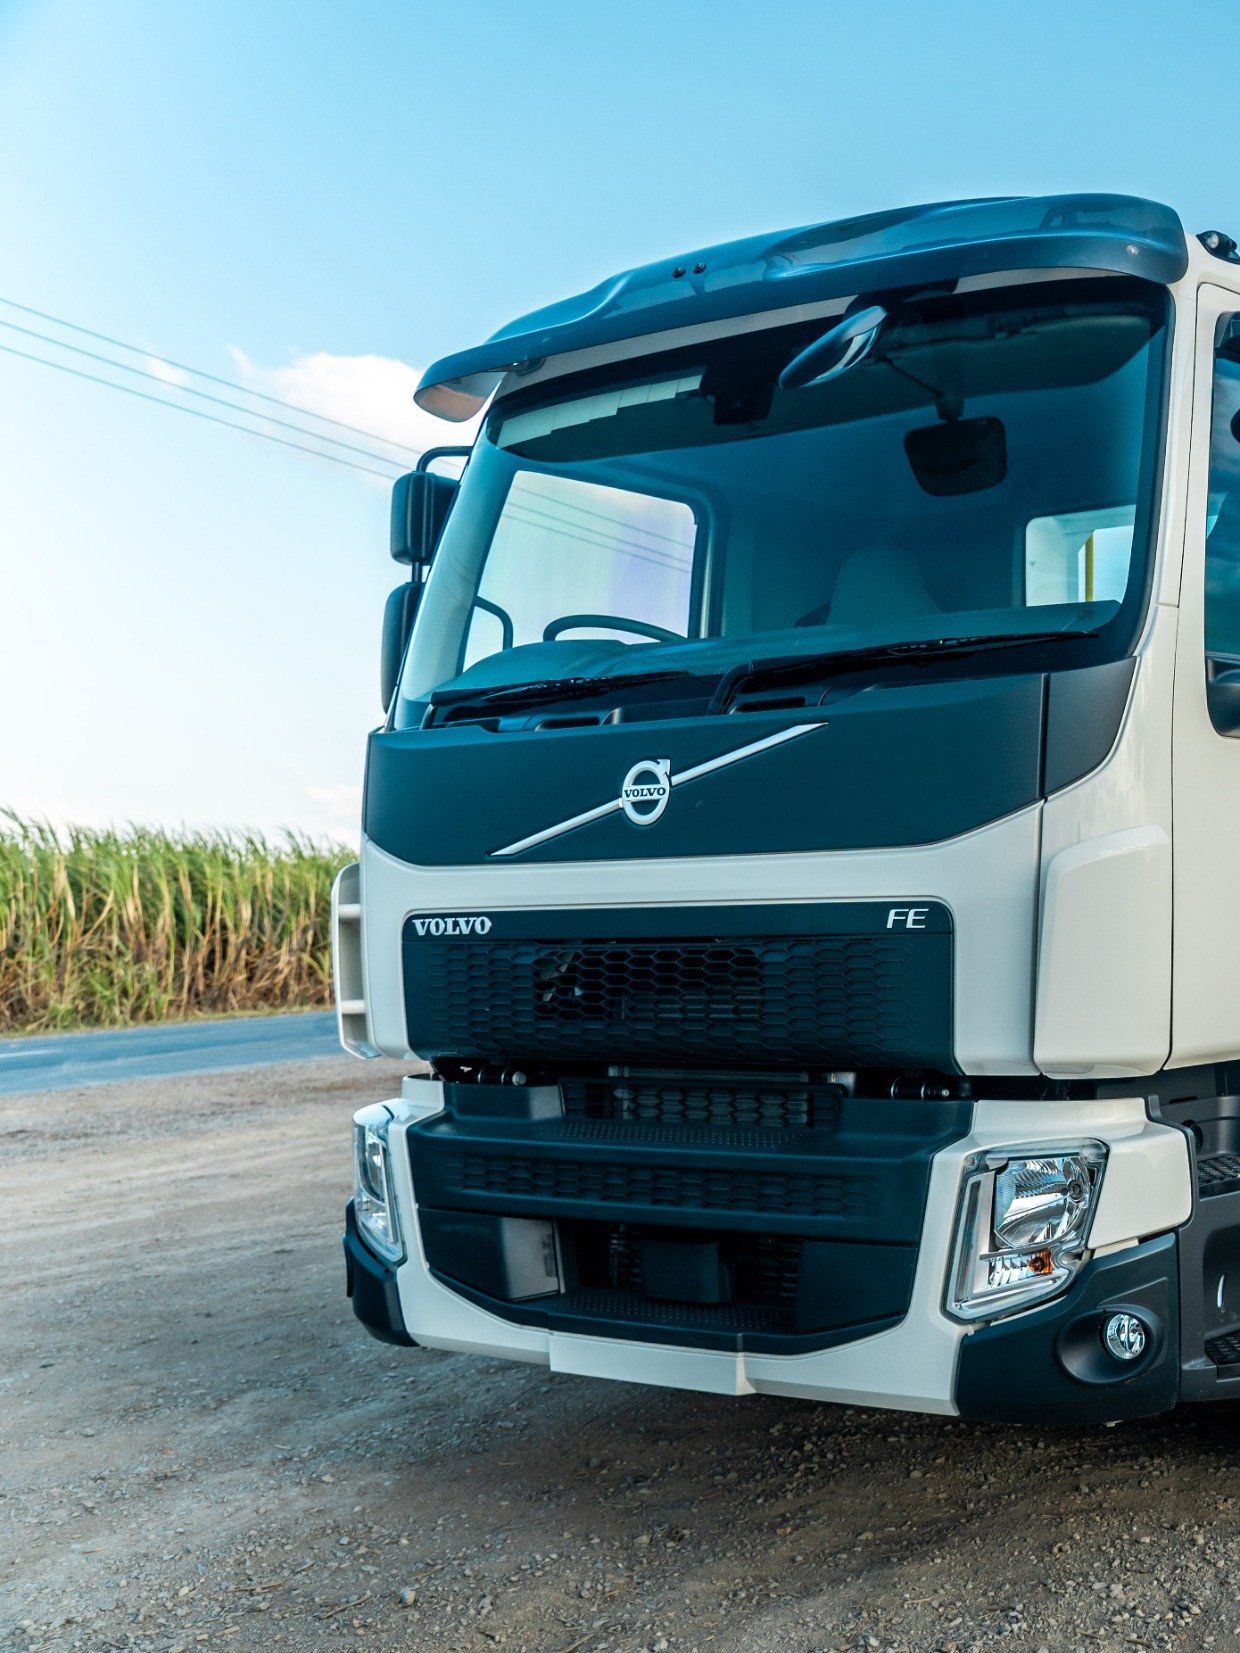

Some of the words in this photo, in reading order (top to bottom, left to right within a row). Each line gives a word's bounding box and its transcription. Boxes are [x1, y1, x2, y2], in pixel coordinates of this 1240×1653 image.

[624, 787, 666, 798] VOLVO
[412, 916, 492, 936] VOLVO
[886, 908, 930, 929] FE
